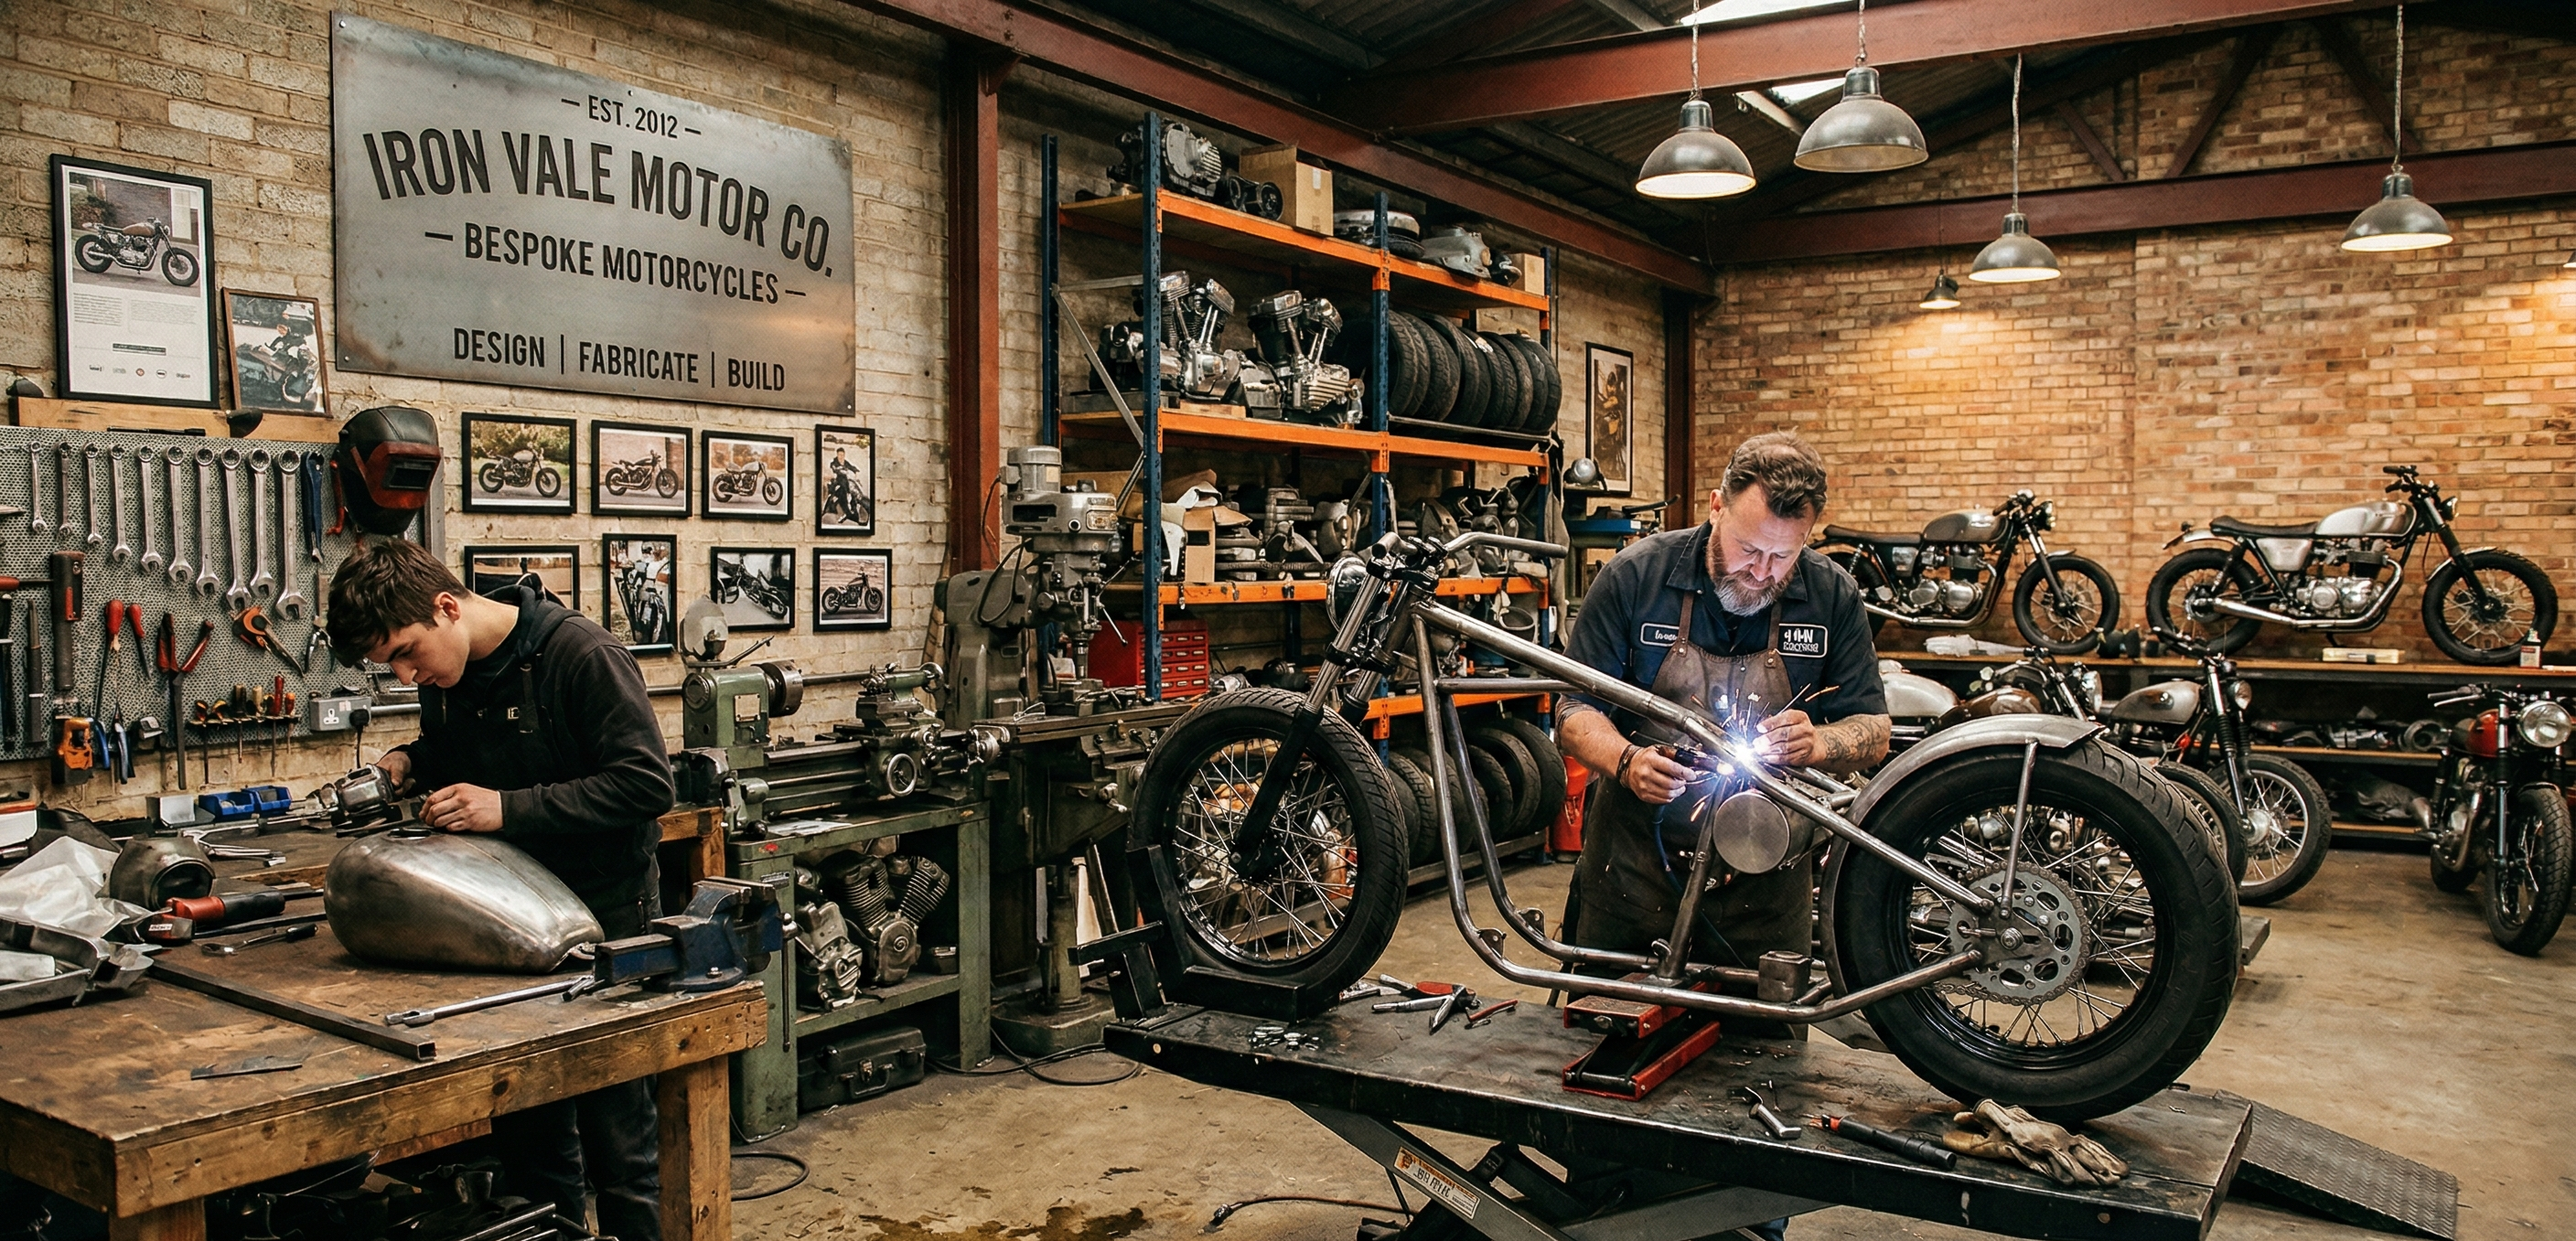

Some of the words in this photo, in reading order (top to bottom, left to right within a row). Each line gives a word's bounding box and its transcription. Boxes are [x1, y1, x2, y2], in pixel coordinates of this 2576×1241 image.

[588, 94, 631, 127] EST.
[635, 108, 678, 139] 2012
[362, 128, 491, 200] IRON
[500, 131, 615, 205] VALE
[631, 150, 769, 247] MOTOR
[780, 203, 833, 278] CO.
[465, 222, 595, 276] BESPOKE
[603, 244, 779, 305] MOTORCYCLES
[454, 327, 545, 369] DESIGN
[579, 341, 699, 384] FABRICATE
[727, 358, 786, 392] BUILD
